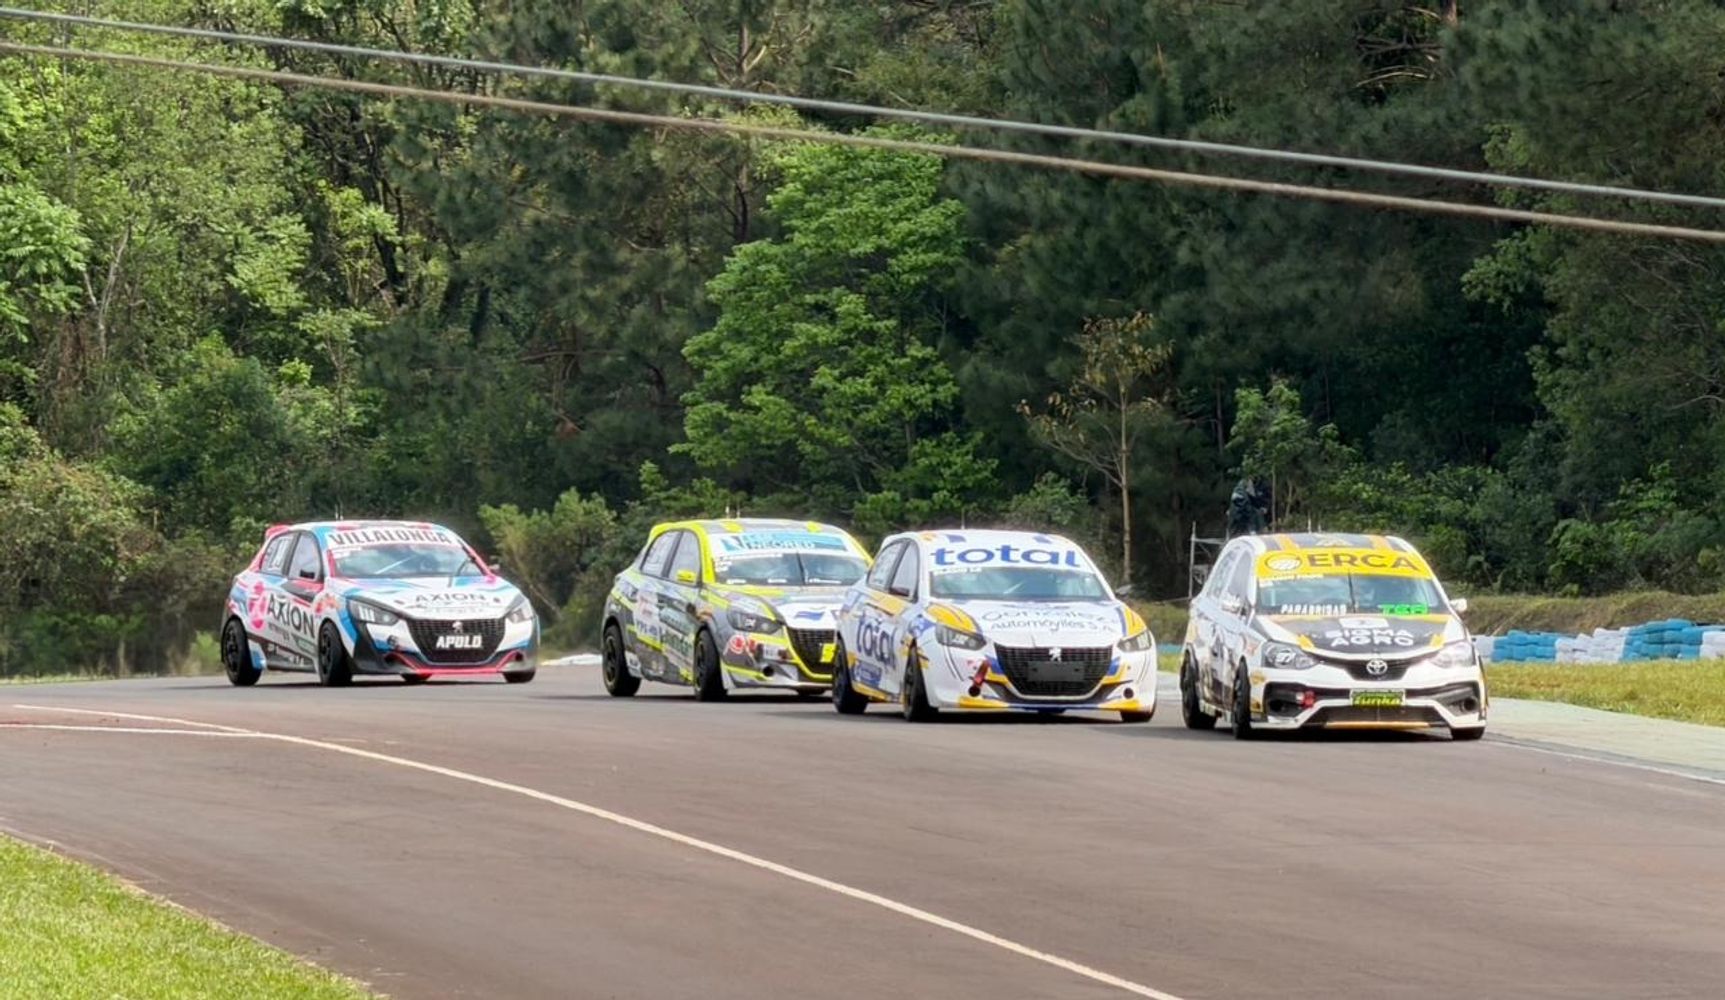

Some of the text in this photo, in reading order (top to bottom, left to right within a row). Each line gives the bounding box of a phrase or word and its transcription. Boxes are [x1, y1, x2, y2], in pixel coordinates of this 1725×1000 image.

[329, 530, 452, 544] VILLALONGA
[931, 545, 1079, 567] total
[1307, 553, 1422, 571] ERCA
[268, 593, 315, 639] AXION
[1325, 629, 1414, 638] SIGMA
[436, 635, 482, 649] APOLO
[1330, 636, 1413, 647] AGRO
